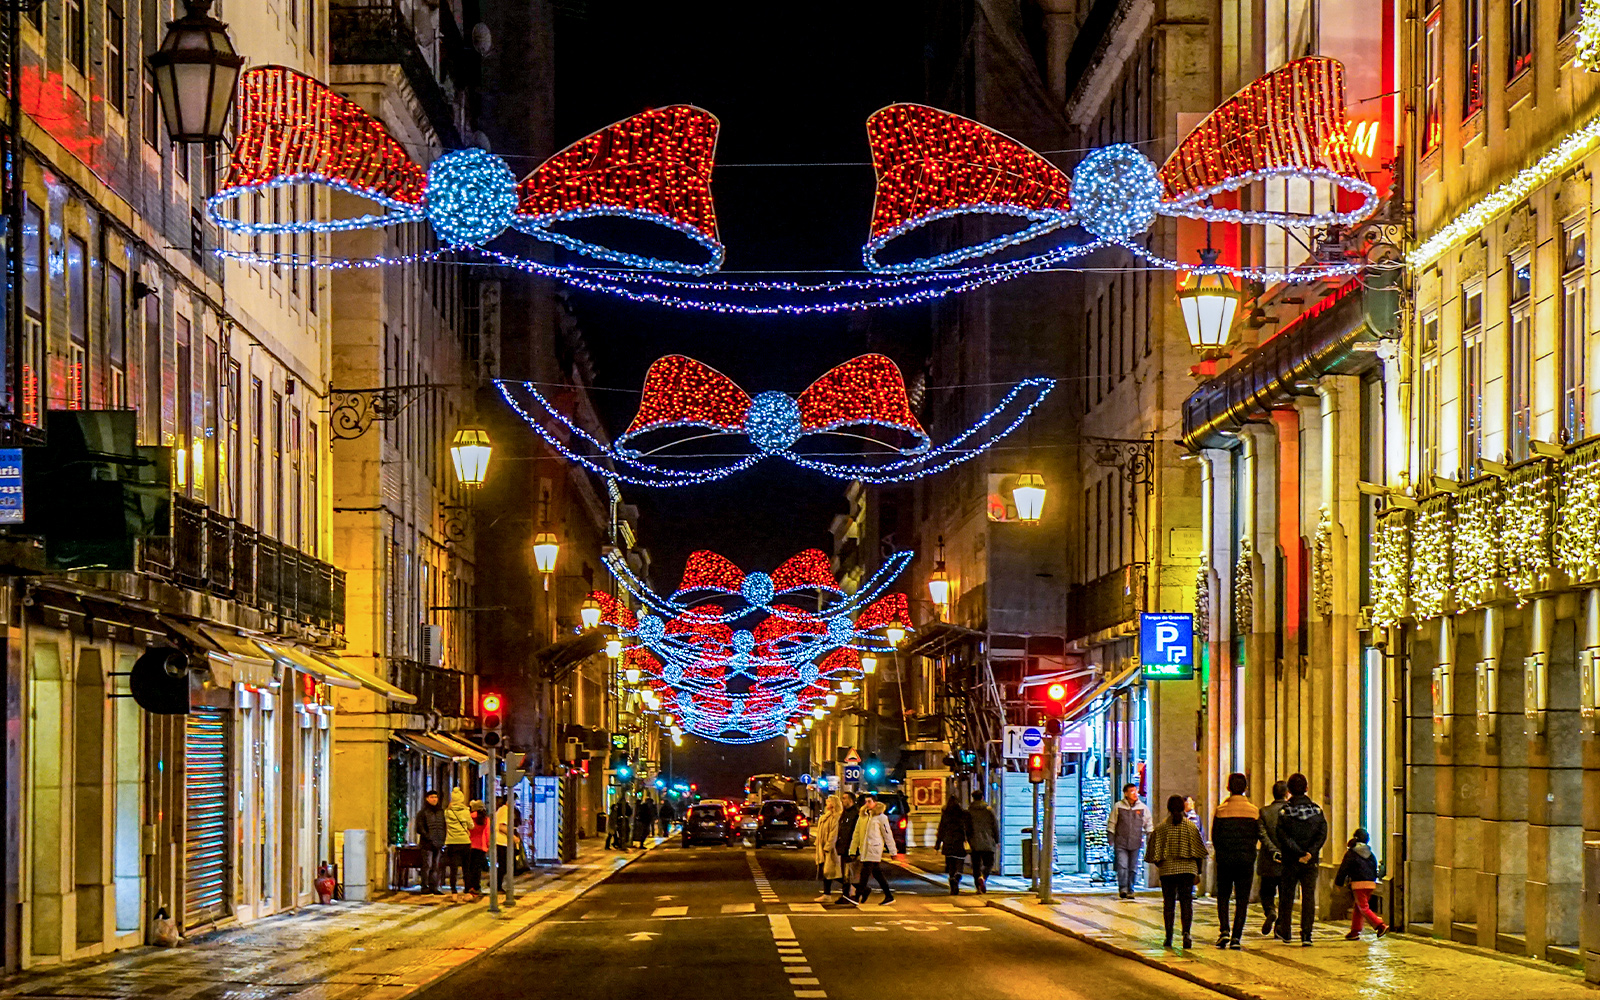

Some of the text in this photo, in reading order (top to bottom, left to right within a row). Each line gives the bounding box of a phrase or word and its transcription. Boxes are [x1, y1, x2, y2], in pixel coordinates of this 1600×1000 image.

[1156, 626, 1179, 652] P
[845, 769, 860, 779] 30
[914, 780, 941, 804] pf
